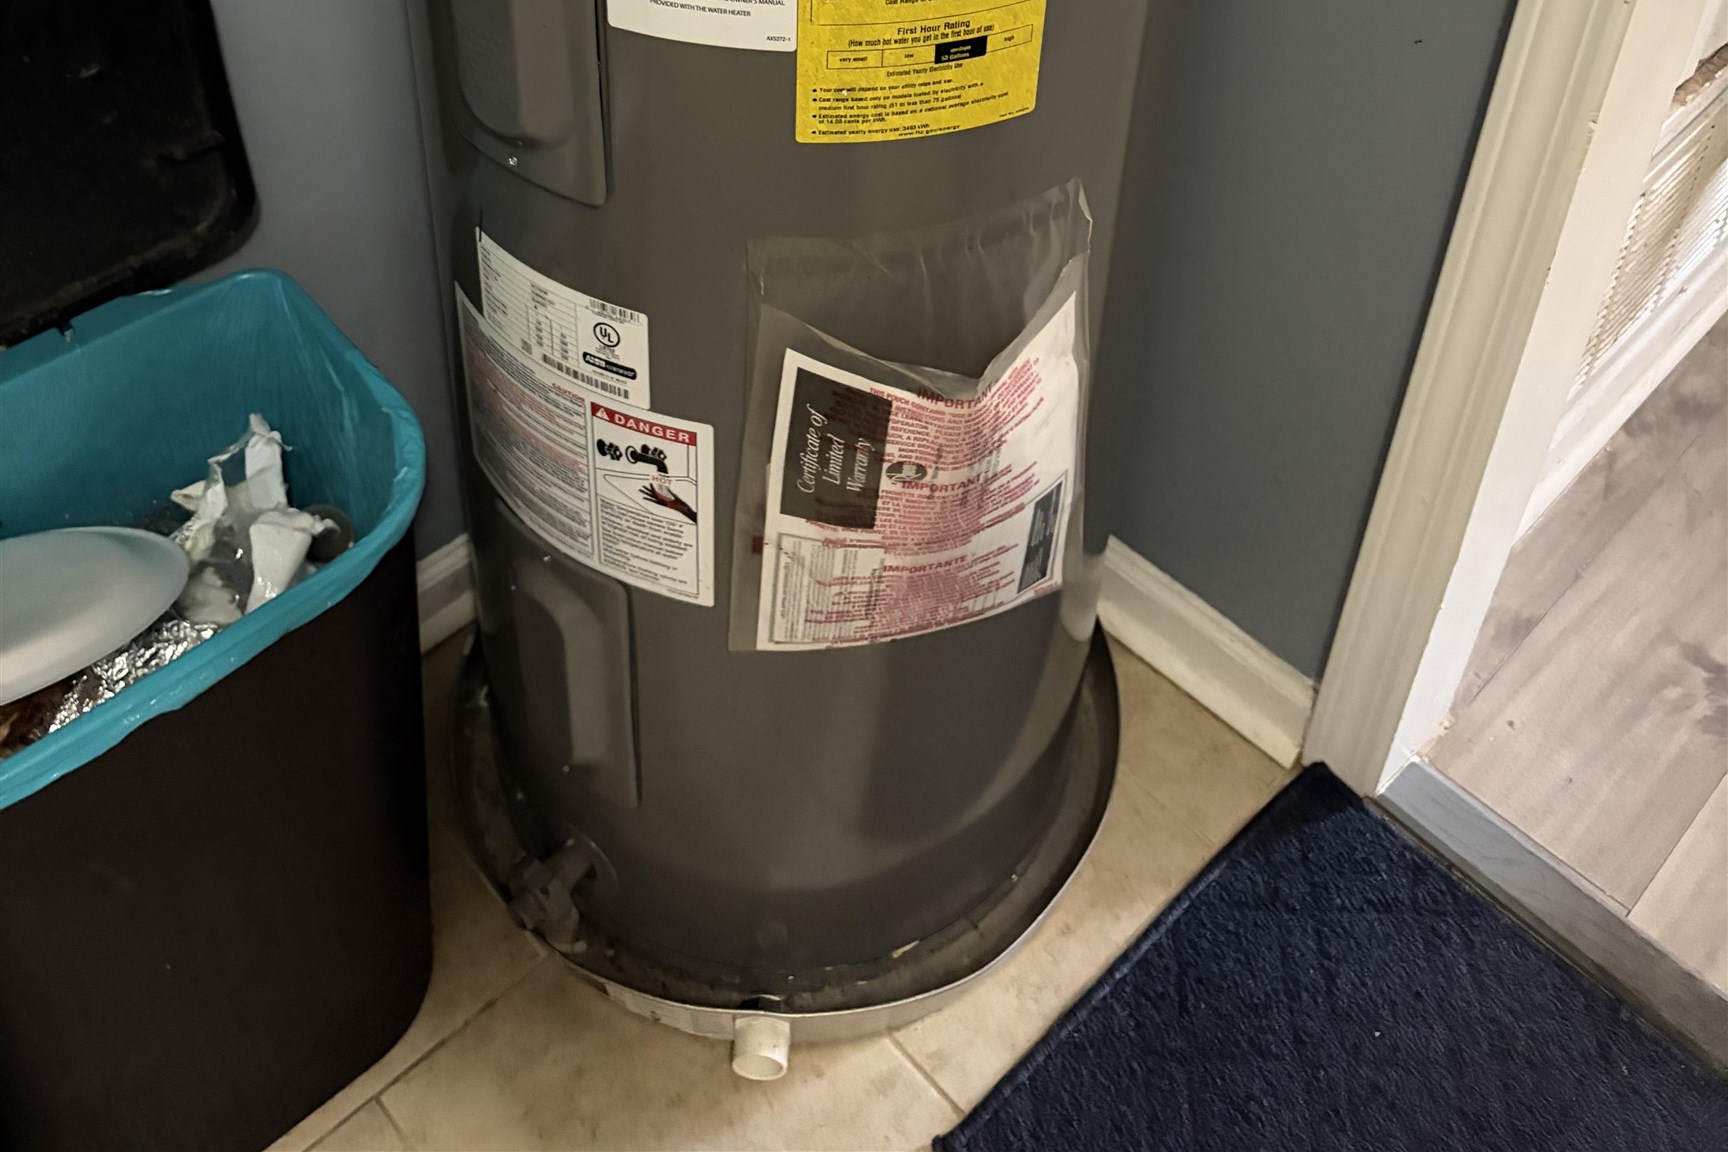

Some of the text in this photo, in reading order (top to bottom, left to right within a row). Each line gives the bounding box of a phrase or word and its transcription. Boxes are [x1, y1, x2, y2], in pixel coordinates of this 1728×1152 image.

[679, 3, 695, 11] WITH
[695, 5, 707, 13] THE
[707, 6, 727, 15] WATER
[728, 9, 751, 17] HEATER
[848, 26, 983, 48] (How much hot water you get the first hour of
[897, 20, 971, 35] First Hour Rating
[600, 326, 614, 344] UL
[917, 384, 994, 409] IMPORTANT
[614, 413, 690, 443] DANGER
[796, 403, 828, 493] Certificate of
[822, 433, 846, 485] Limited
[846, 437, 875, 492] Warranty
[652, 474, 673, 486] HOT
[901, 472, 982, 493] IMPORTANT
[882, 555, 967, 574] IMPORTANTE
